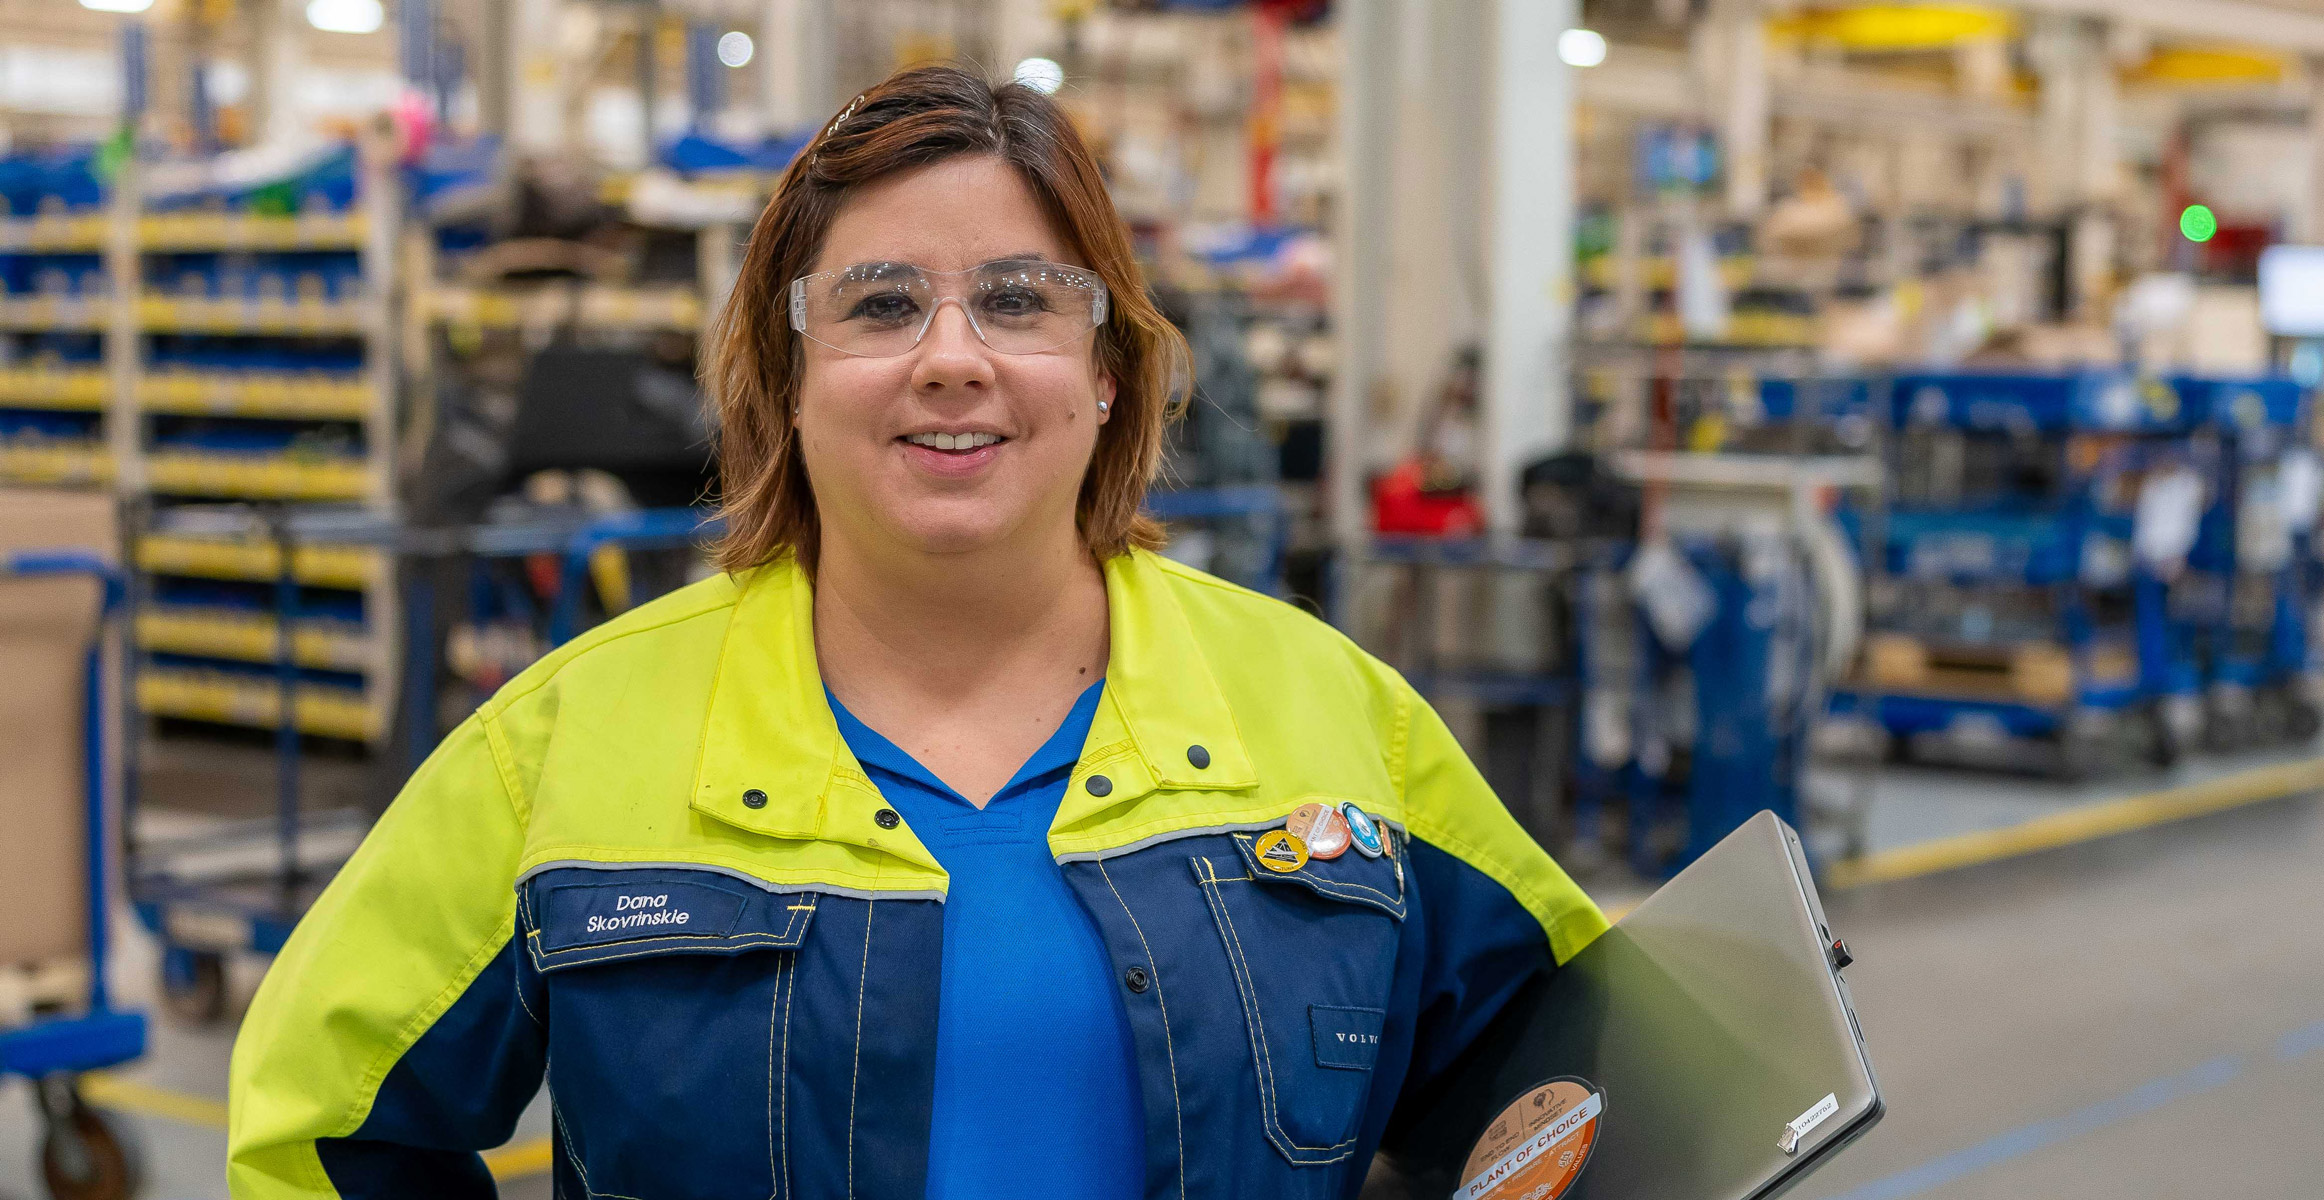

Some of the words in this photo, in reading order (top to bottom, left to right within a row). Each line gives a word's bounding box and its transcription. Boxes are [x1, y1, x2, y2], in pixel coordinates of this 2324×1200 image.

[616, 894, 668, 911] Dana
[586, 909, 690, 933] Skovrinskie
[1469, 1159, 1512, 1196] PLANT
[1516, 1144, 1533, 1163] OF
[1537, 1106, 1588, 1148] CHOICE
[1570, 1143, 1588, 1172] VALUES
